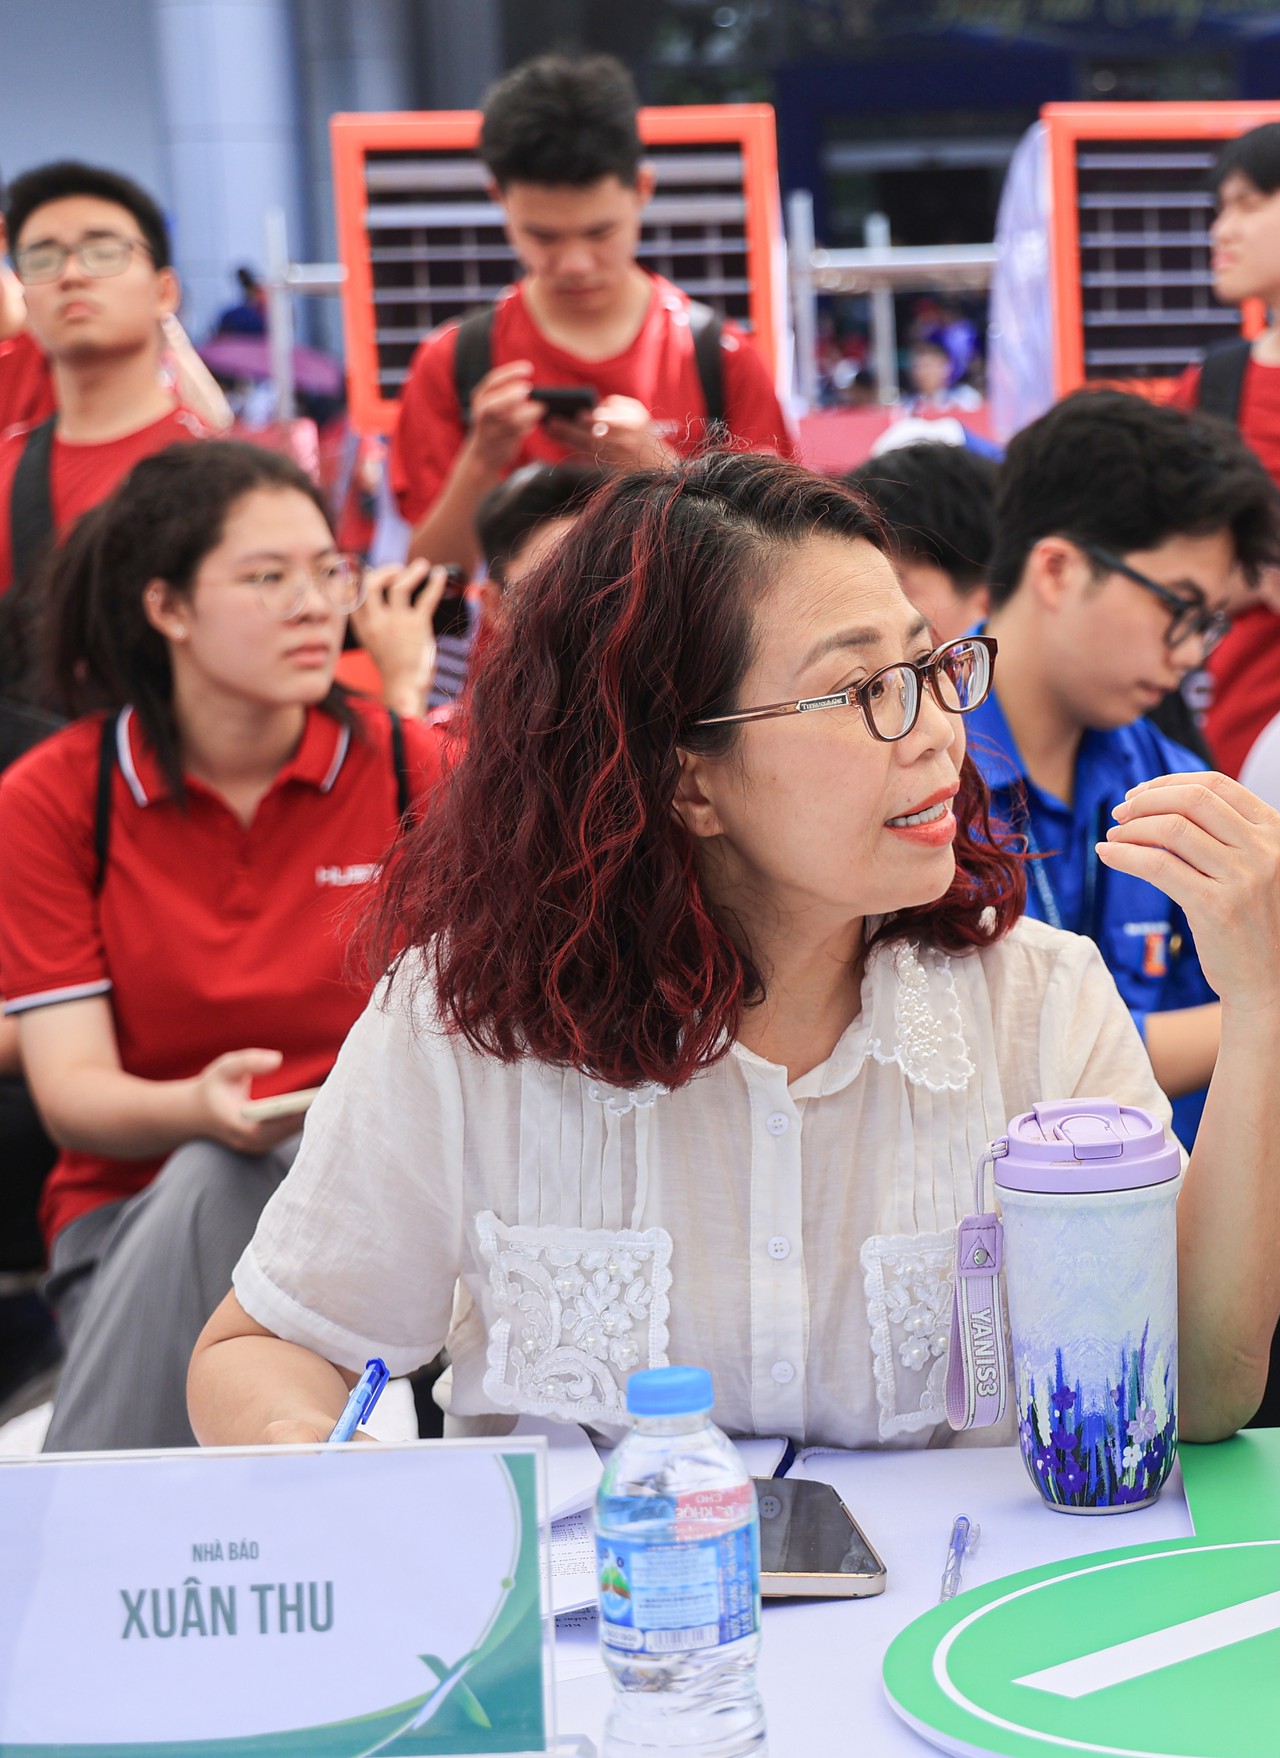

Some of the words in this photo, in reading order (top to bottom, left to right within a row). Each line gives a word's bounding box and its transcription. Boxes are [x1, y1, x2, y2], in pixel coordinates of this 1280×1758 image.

[971, 1307, 999, 1397] YANIS3
[192, 1539, 224, 1562] NHÀ
[228, 1538, 259, 1560] BÁO
[119, 1576, 237, 1640] XUÂN
[249, 1580, 334, 1635] THU
